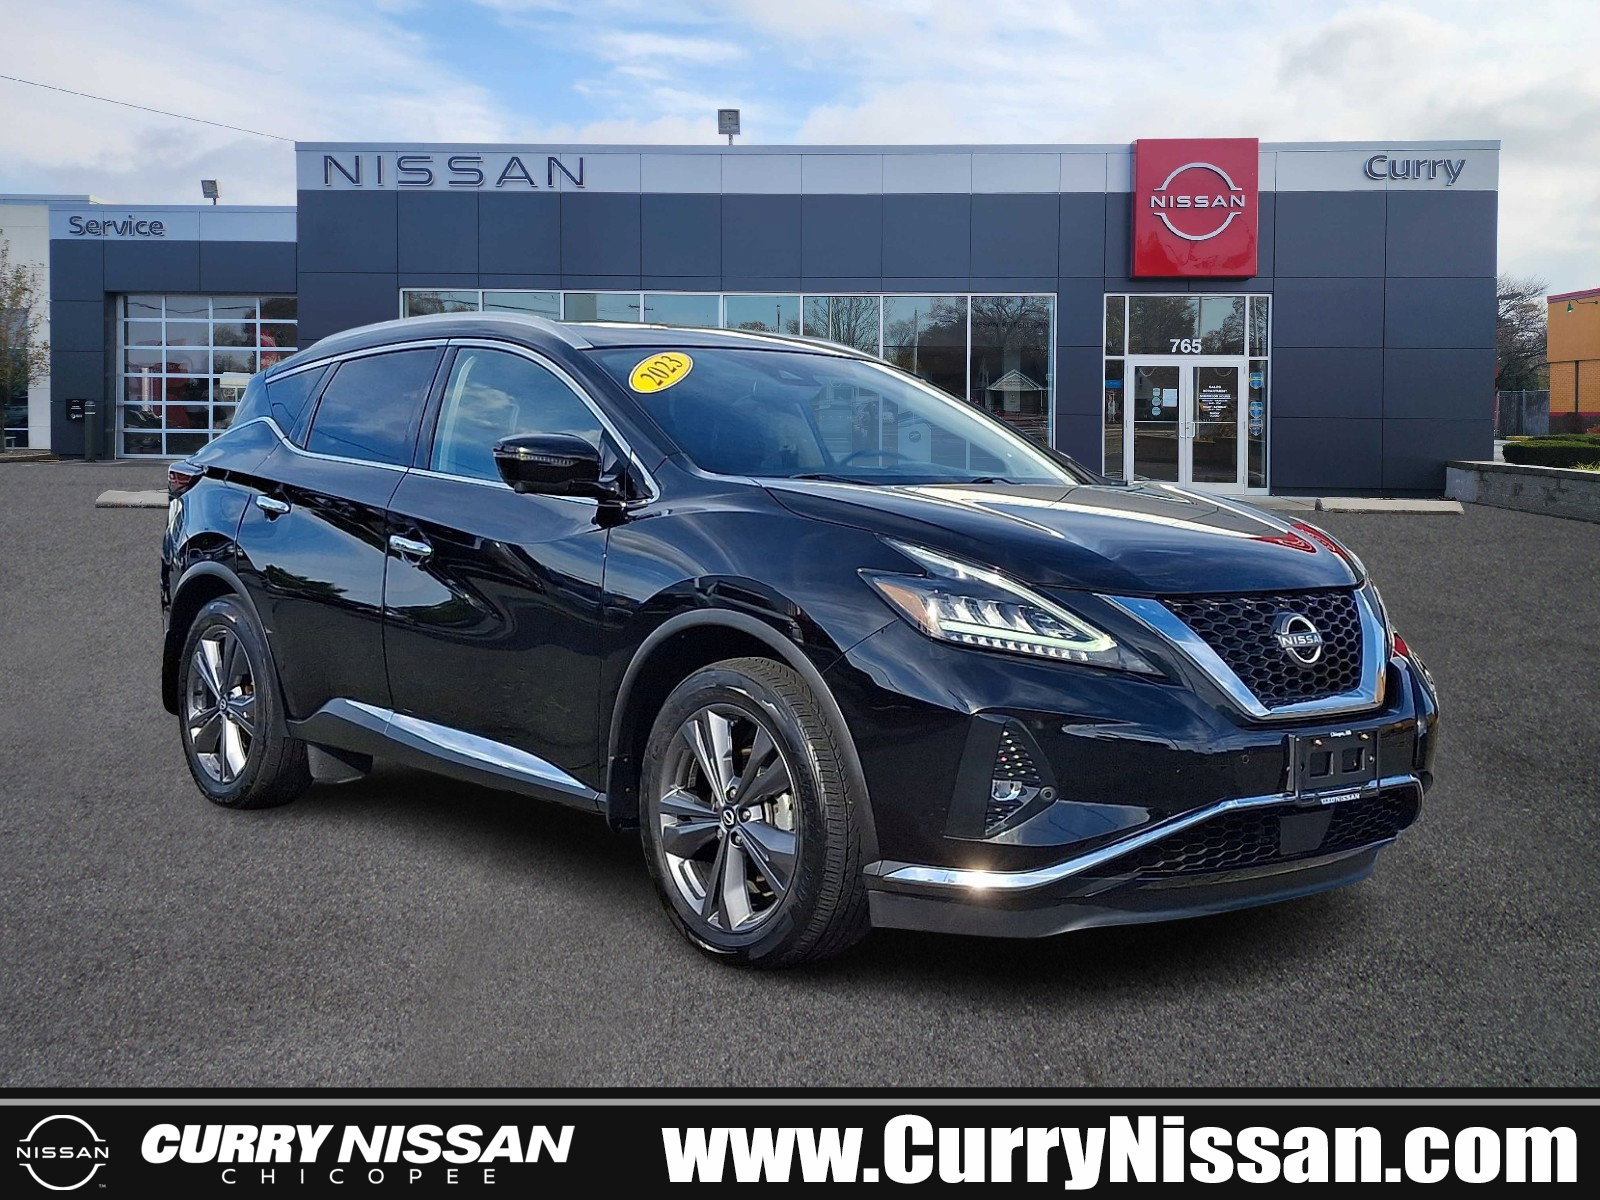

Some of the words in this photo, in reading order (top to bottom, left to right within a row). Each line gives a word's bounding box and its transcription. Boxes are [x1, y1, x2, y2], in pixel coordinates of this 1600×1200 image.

[323, 154, 585, 188] NISSAN
[1362, 154, 1467, 186] Curry
[1149, 194, 1246, 208] NISSAN
[68, 214, 165, 236] Service
[1169, 338, 1203, 354] 765
[640, 355, 683, 386] 2023
